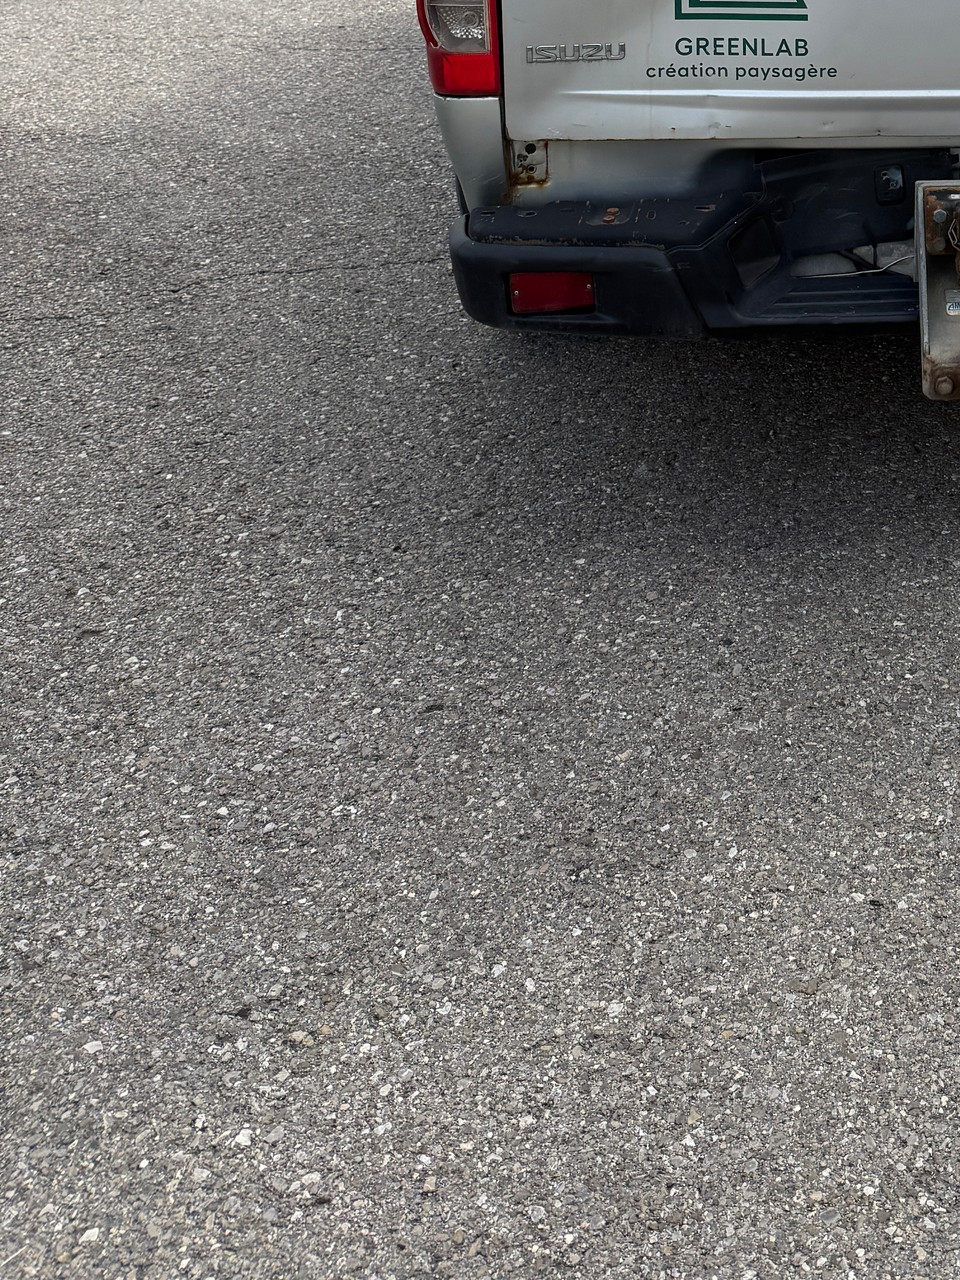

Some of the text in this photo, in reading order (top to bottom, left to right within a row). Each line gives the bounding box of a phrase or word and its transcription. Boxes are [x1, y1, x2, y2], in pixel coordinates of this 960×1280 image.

[526, 42, 626, 63] ISUZU
[675, 37, 809, 57] GREENLAB
[646, 63, 838, 81] création paysagère
